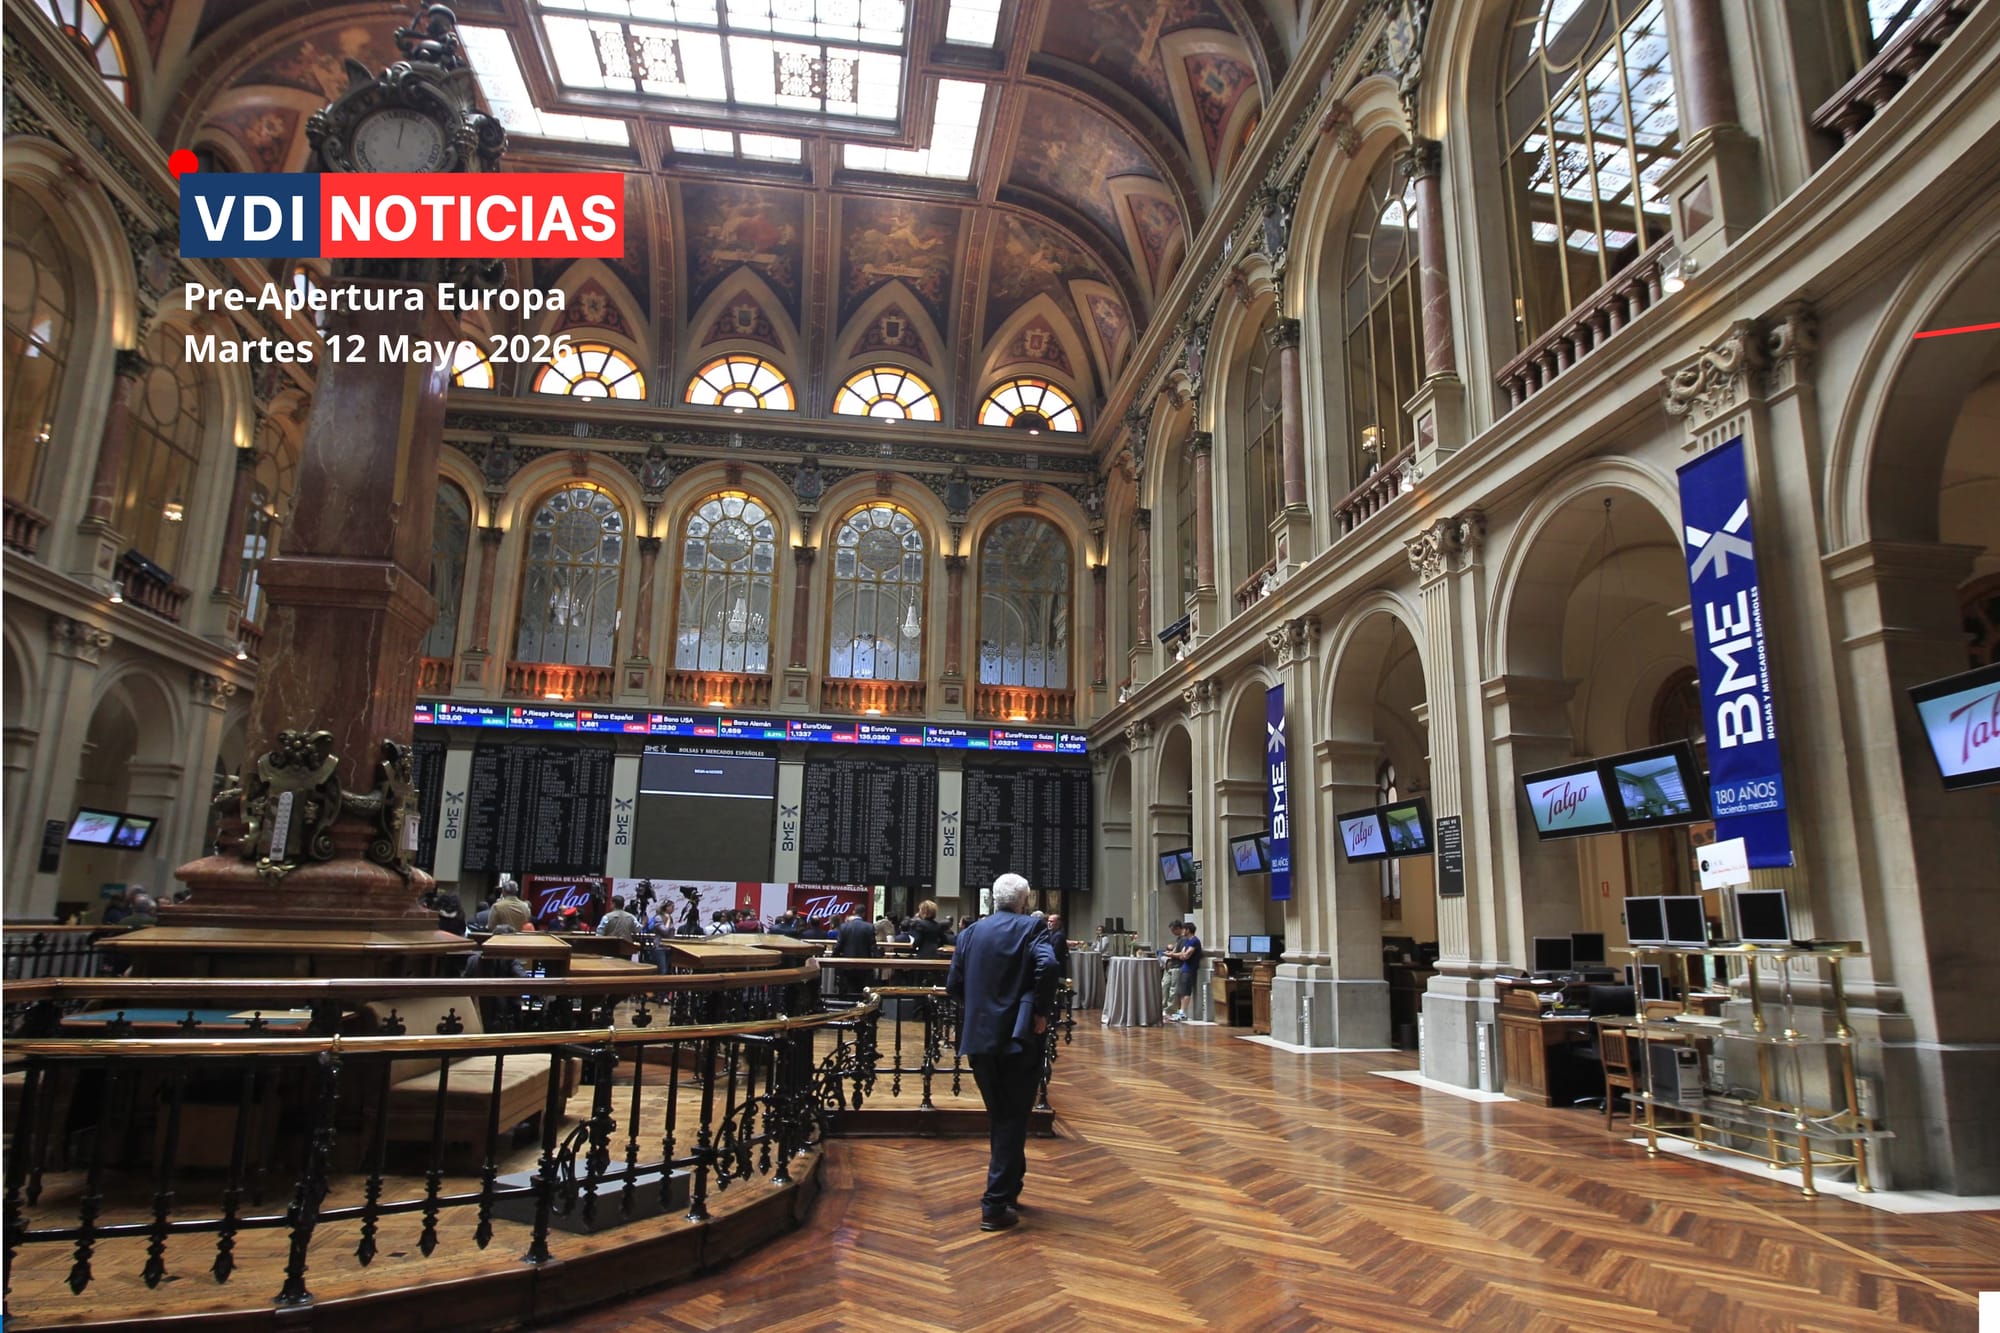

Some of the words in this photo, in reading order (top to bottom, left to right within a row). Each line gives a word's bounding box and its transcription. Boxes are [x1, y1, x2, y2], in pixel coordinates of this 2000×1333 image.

[1750, 585, 1763, 638] ESPAÑOLES
[1705, 589, 1763, 749] BME
[1756, 639, 1770, 693] MERCADOS
[550, 711, 575, 719] Portugal
[610, 713, 634, 721] Español
[1765, 703, 1775, 739] BOLSAS
[1272, 761, 1285, 840] BME
[1542, 781, 1589, 825] Talgo
[1715, 788, 1735, 804] 180
[1738, 781, 1777, 801] AÑOS
[1717, 802, 1747, 815] haciendo
[1747, 797, 1778, 810] mercado
[445, 807, 459, 839] BME
[615, 814, 628, 845] BME
[782, 821, 795, 851] BME
[1348, 821, 1373, 852] Talgo
[943, 826, 955, 857] BME
[537, 885, 590, 920] Talgo
